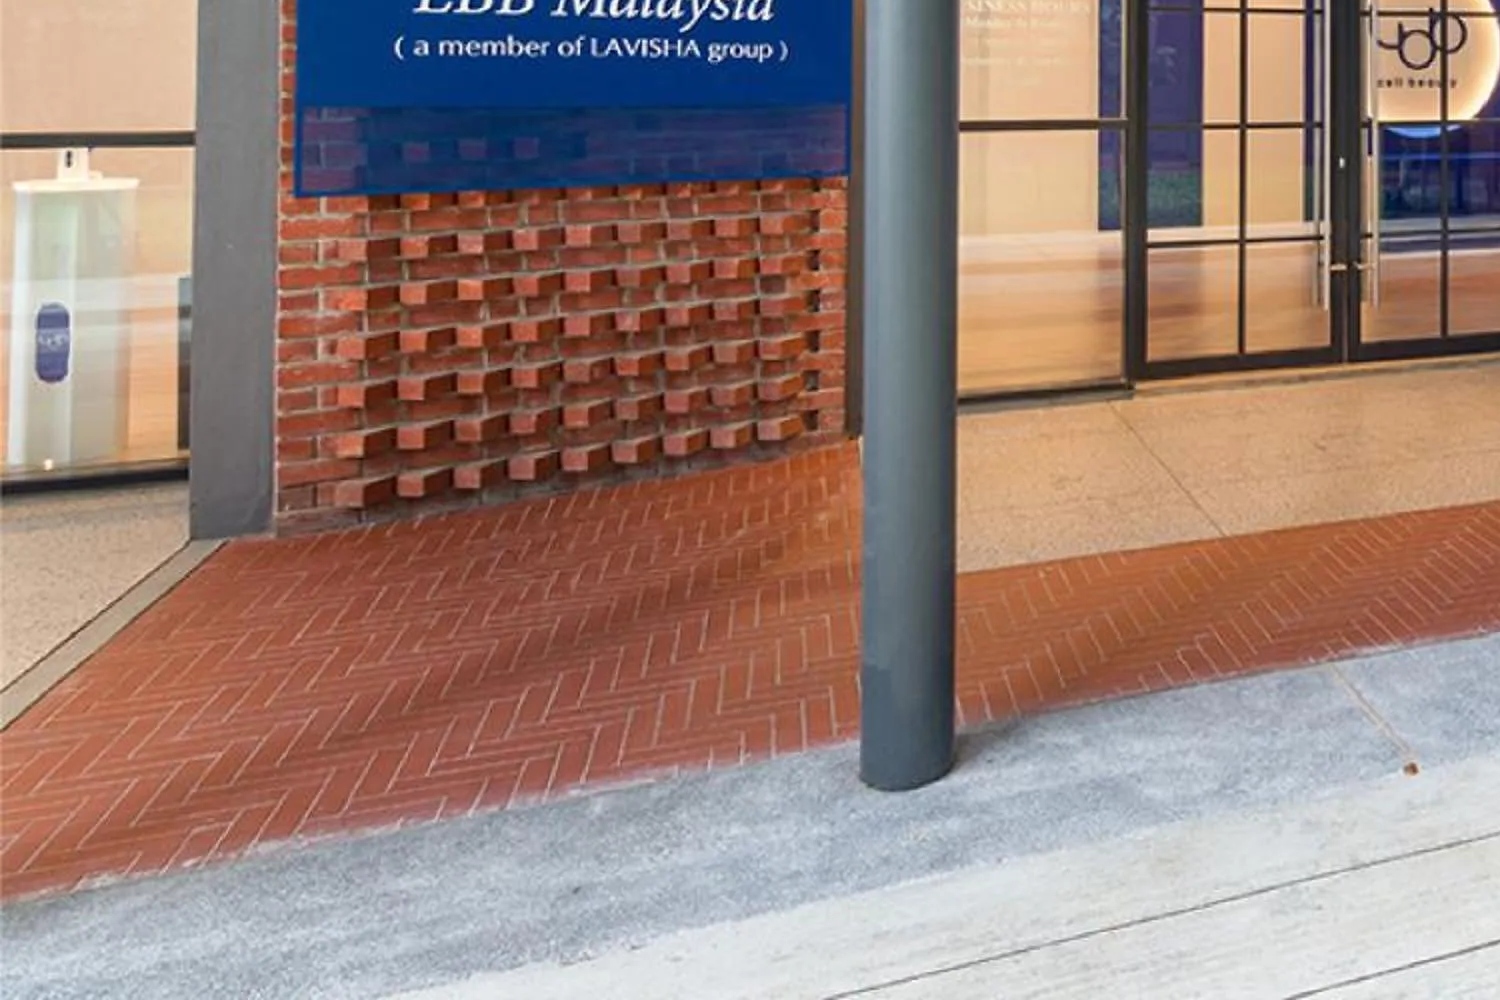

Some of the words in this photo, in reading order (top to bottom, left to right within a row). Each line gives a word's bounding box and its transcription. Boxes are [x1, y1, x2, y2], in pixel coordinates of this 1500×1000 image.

[438, 36, 551, 58] member
[557, 35, 587, 58] of
[590, 37, 701, 58] LAVISHA
[708, 43, 773, 64] group
